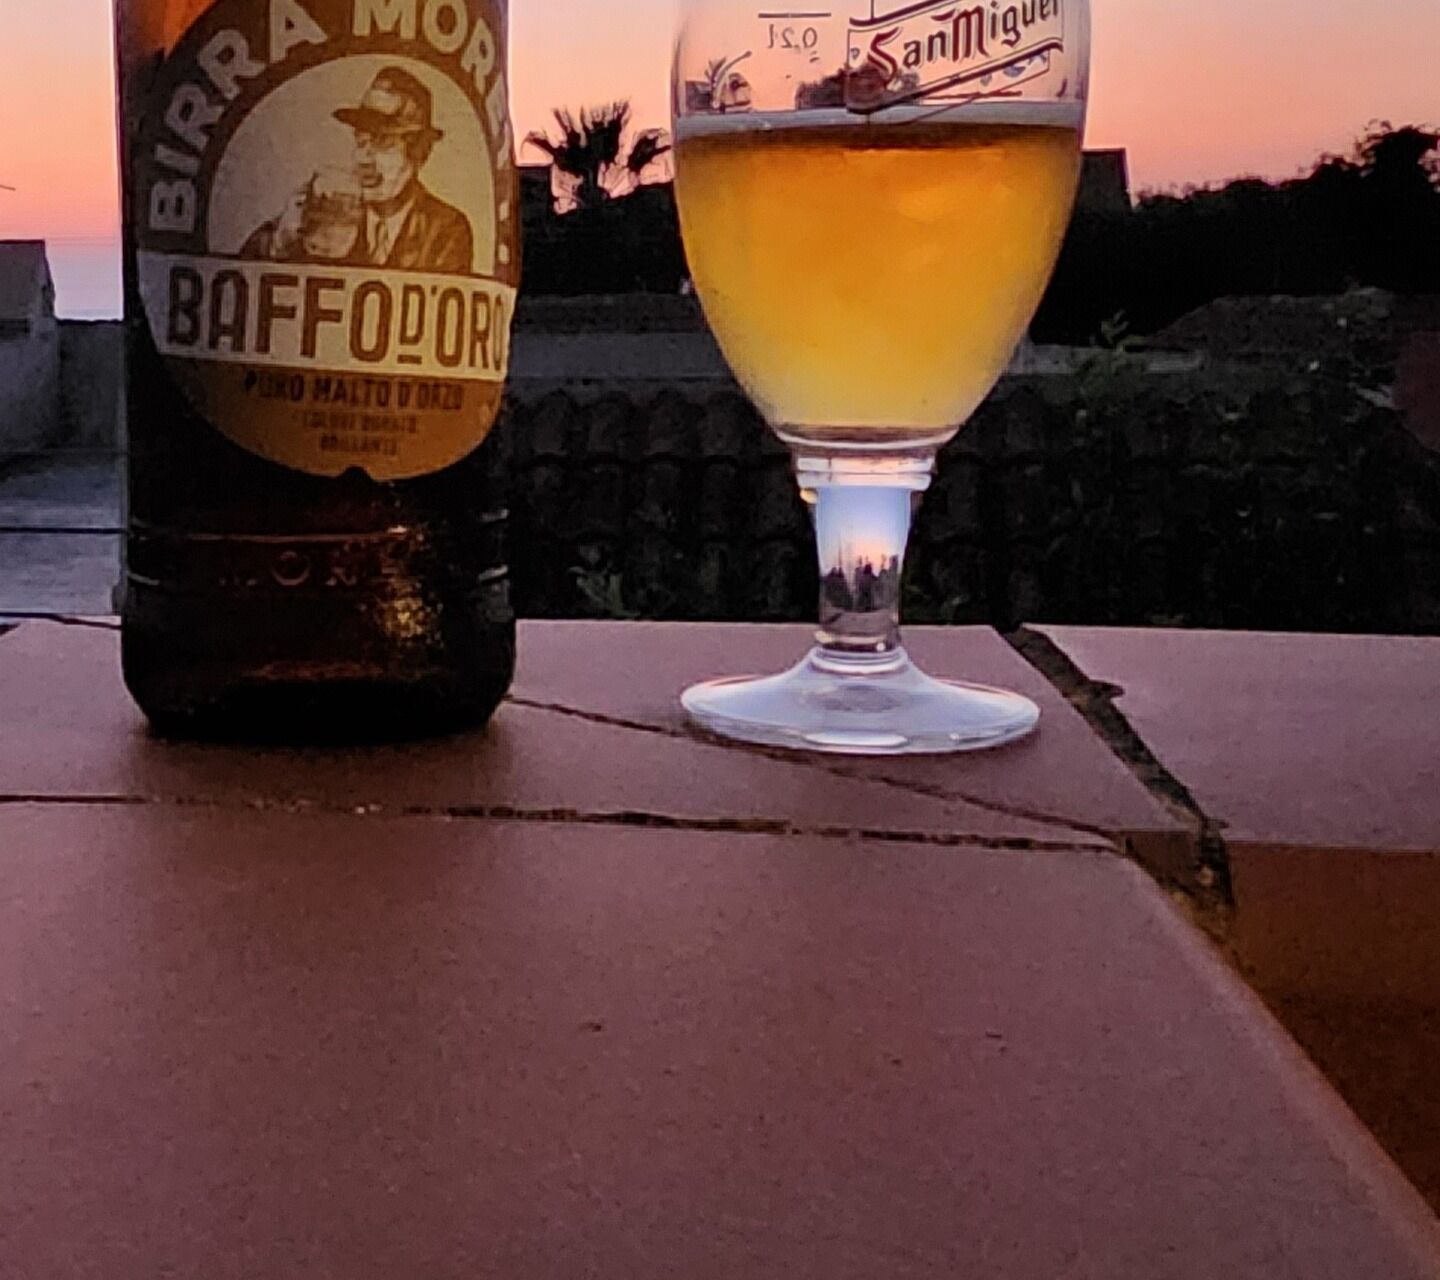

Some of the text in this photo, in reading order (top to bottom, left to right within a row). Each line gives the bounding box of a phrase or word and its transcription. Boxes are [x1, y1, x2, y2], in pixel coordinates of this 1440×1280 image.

[165, 265, 506, 372] BAFFO D'ORO
[312, 376, 391, 408] MALTO
